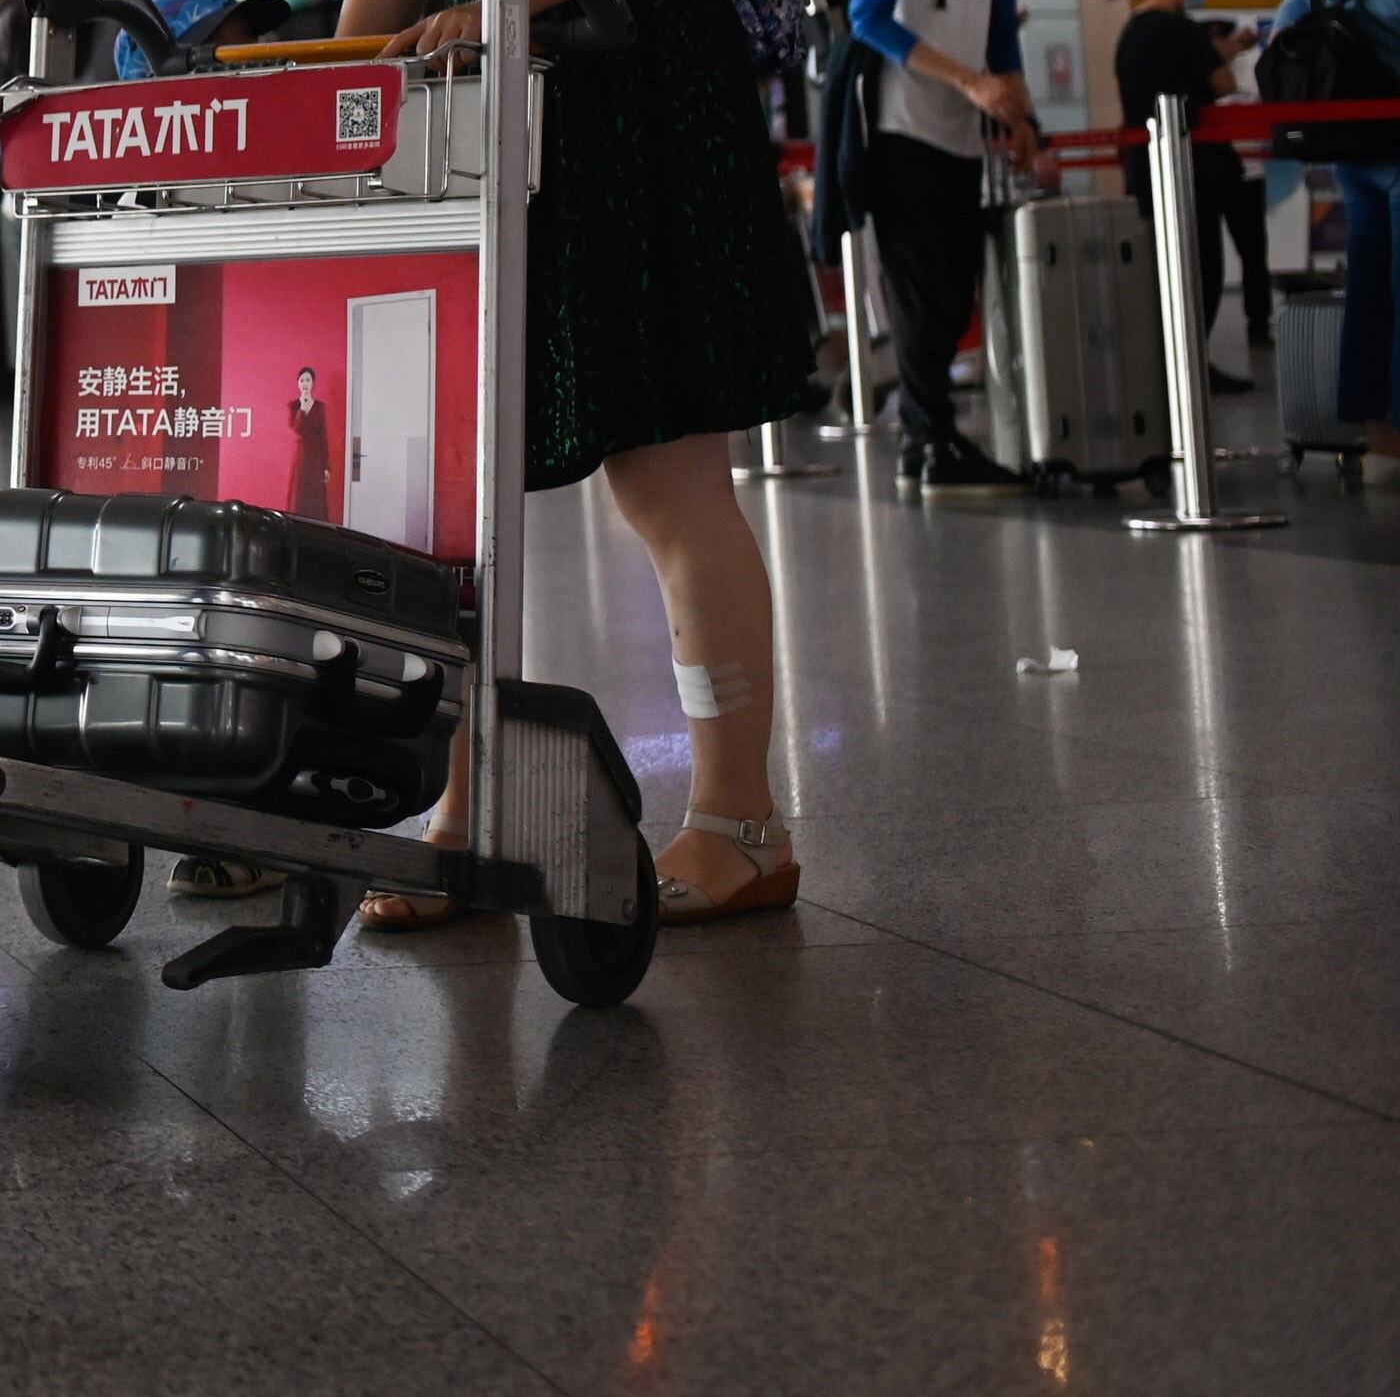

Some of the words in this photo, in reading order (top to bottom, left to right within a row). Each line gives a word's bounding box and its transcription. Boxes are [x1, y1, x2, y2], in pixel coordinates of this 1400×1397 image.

[42, 98, 249, 163] TATA木门
[86, 277, 168, 300] TATA木门
[75, 407, 253, 439] 用TATA静音门
